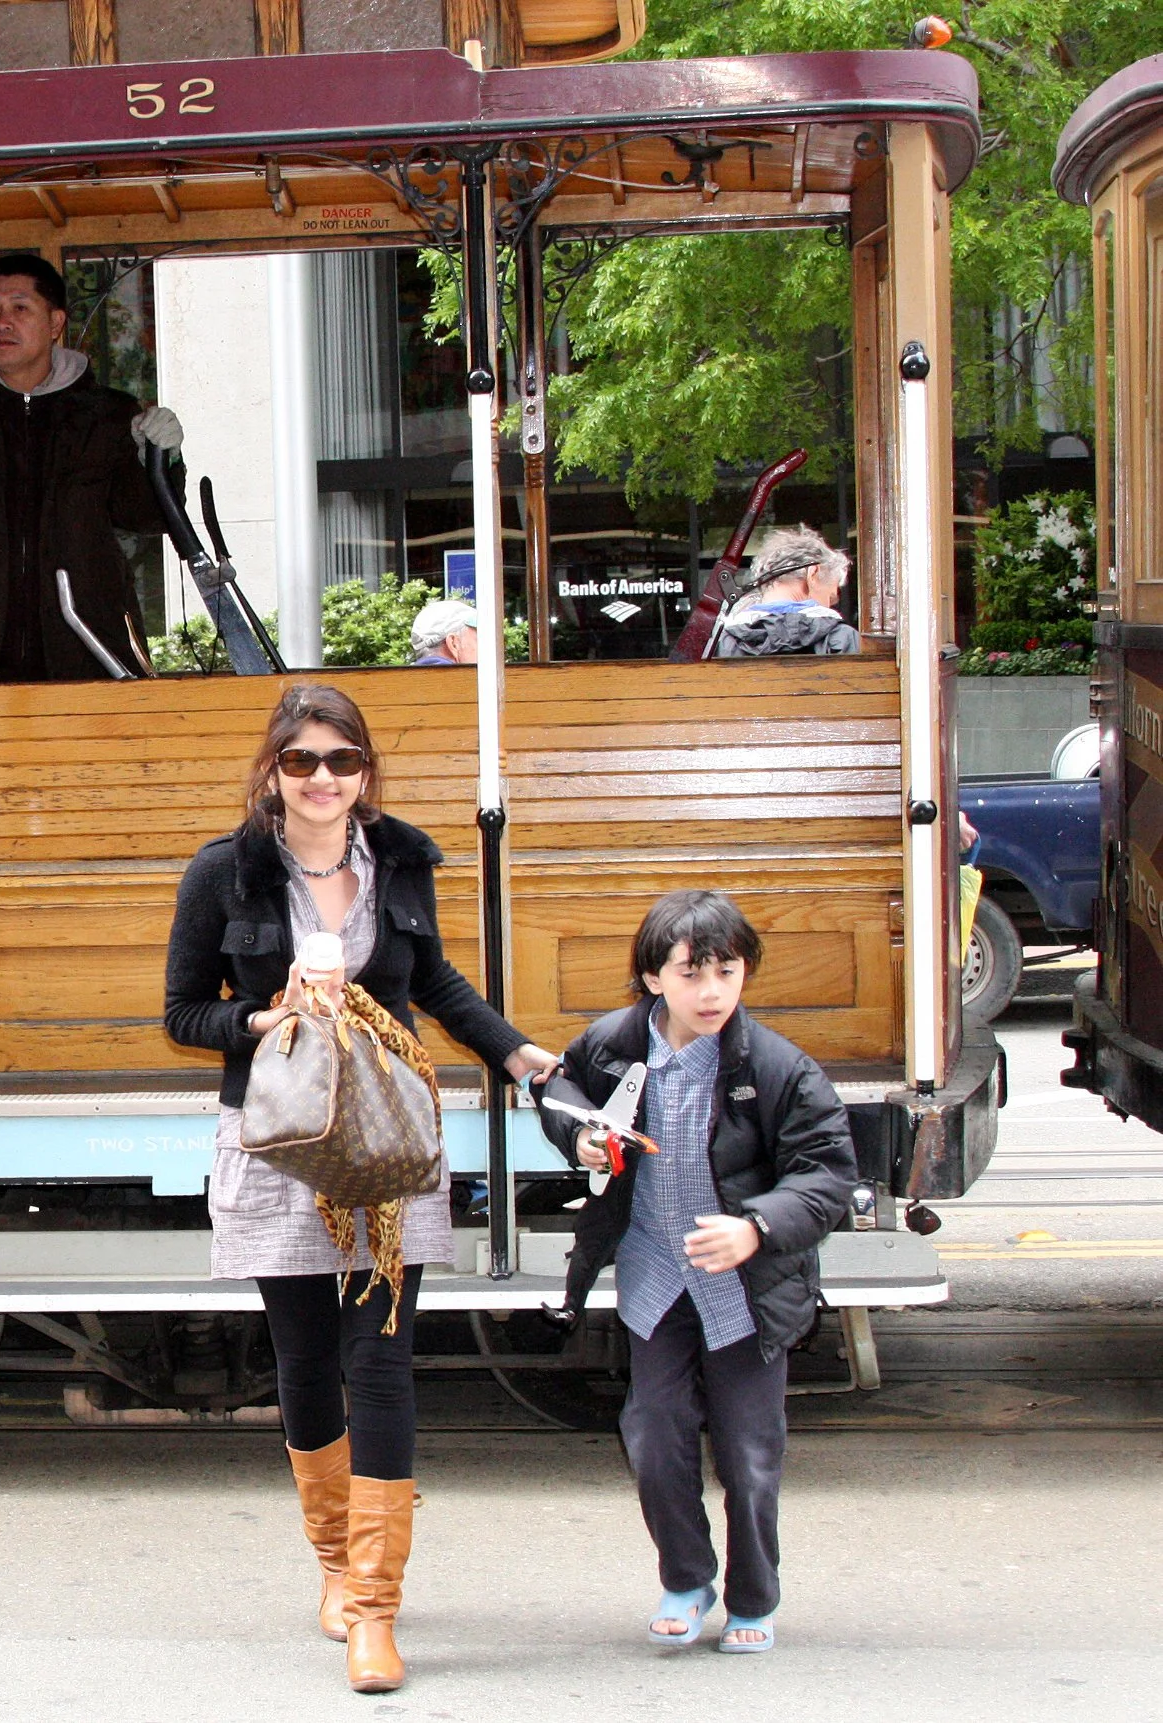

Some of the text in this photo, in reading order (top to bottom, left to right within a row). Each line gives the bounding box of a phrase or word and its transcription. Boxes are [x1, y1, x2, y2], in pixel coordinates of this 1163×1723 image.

[126, 78, 215, 119] 52
[322, 208, 372, 218] DANGER
[303, 219, 390, 230] DO NOT LEAN OUT
[558, 577, 684, 597] Bank of America
